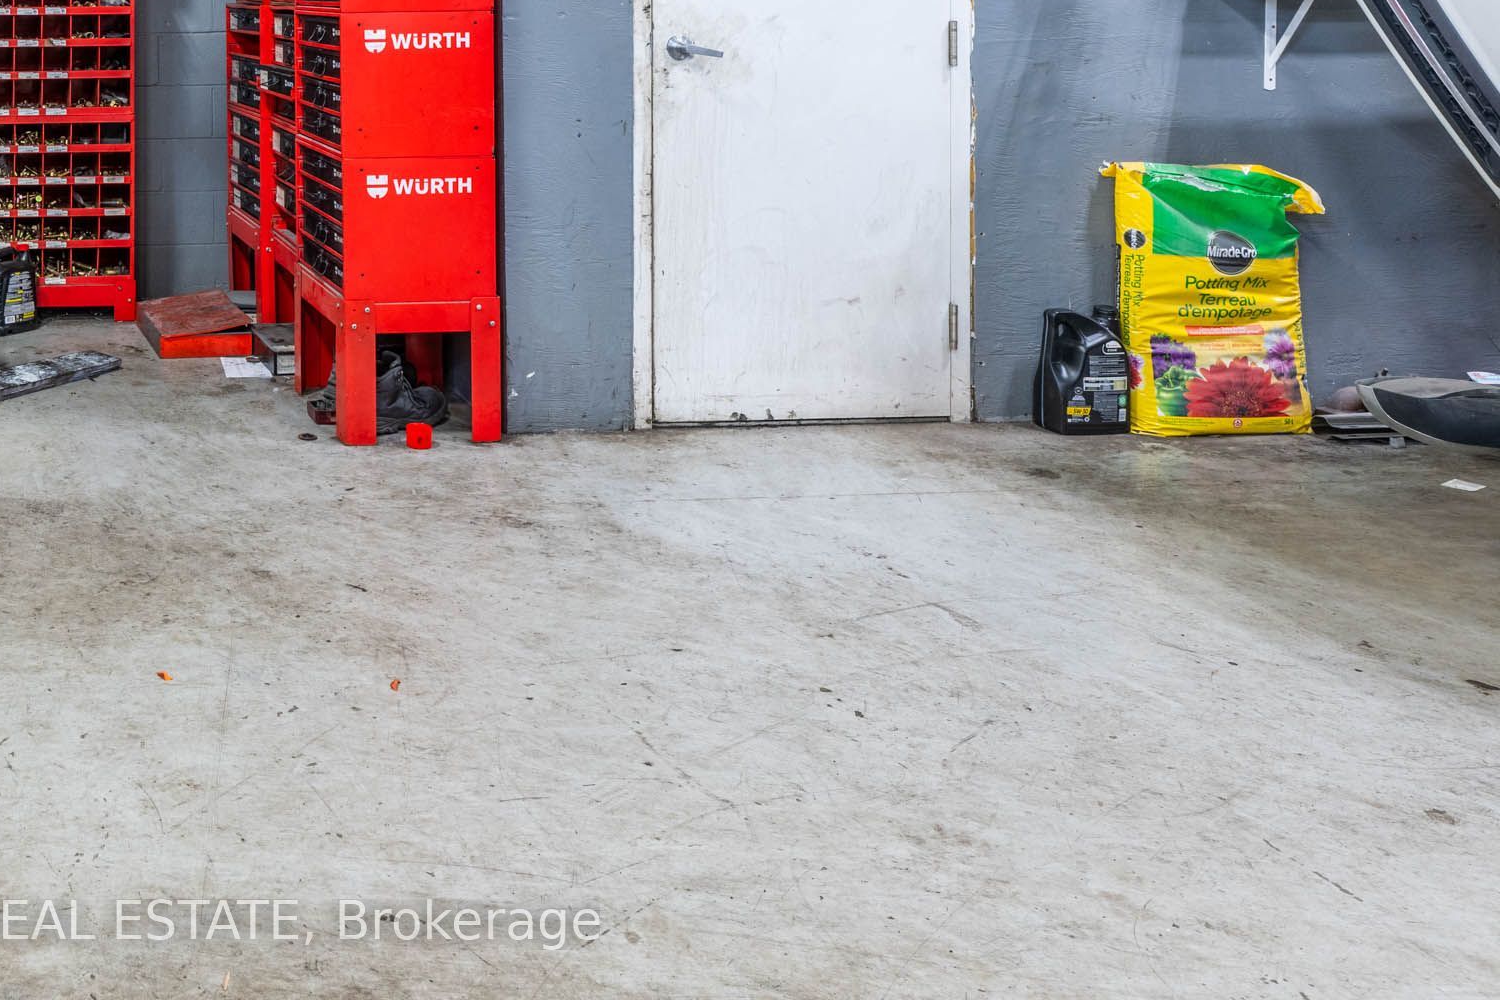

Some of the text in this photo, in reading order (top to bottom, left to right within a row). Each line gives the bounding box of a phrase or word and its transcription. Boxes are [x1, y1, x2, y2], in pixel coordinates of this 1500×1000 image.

[391, 31, 471, 50] WÜRTH
[393, 177, 472, 195] WÜRTH
[1207, 245, 1258, 259] Miracle-Gro
[1123, 253, 1134, 288] Terreau
[1131, 254, 1146, 288] Potting
[1184, 275, 1270, 291] Potting Mix
[1199, 293, 1257, 307] Terreau
[1177, 303, 1273, 321] d'empotage
